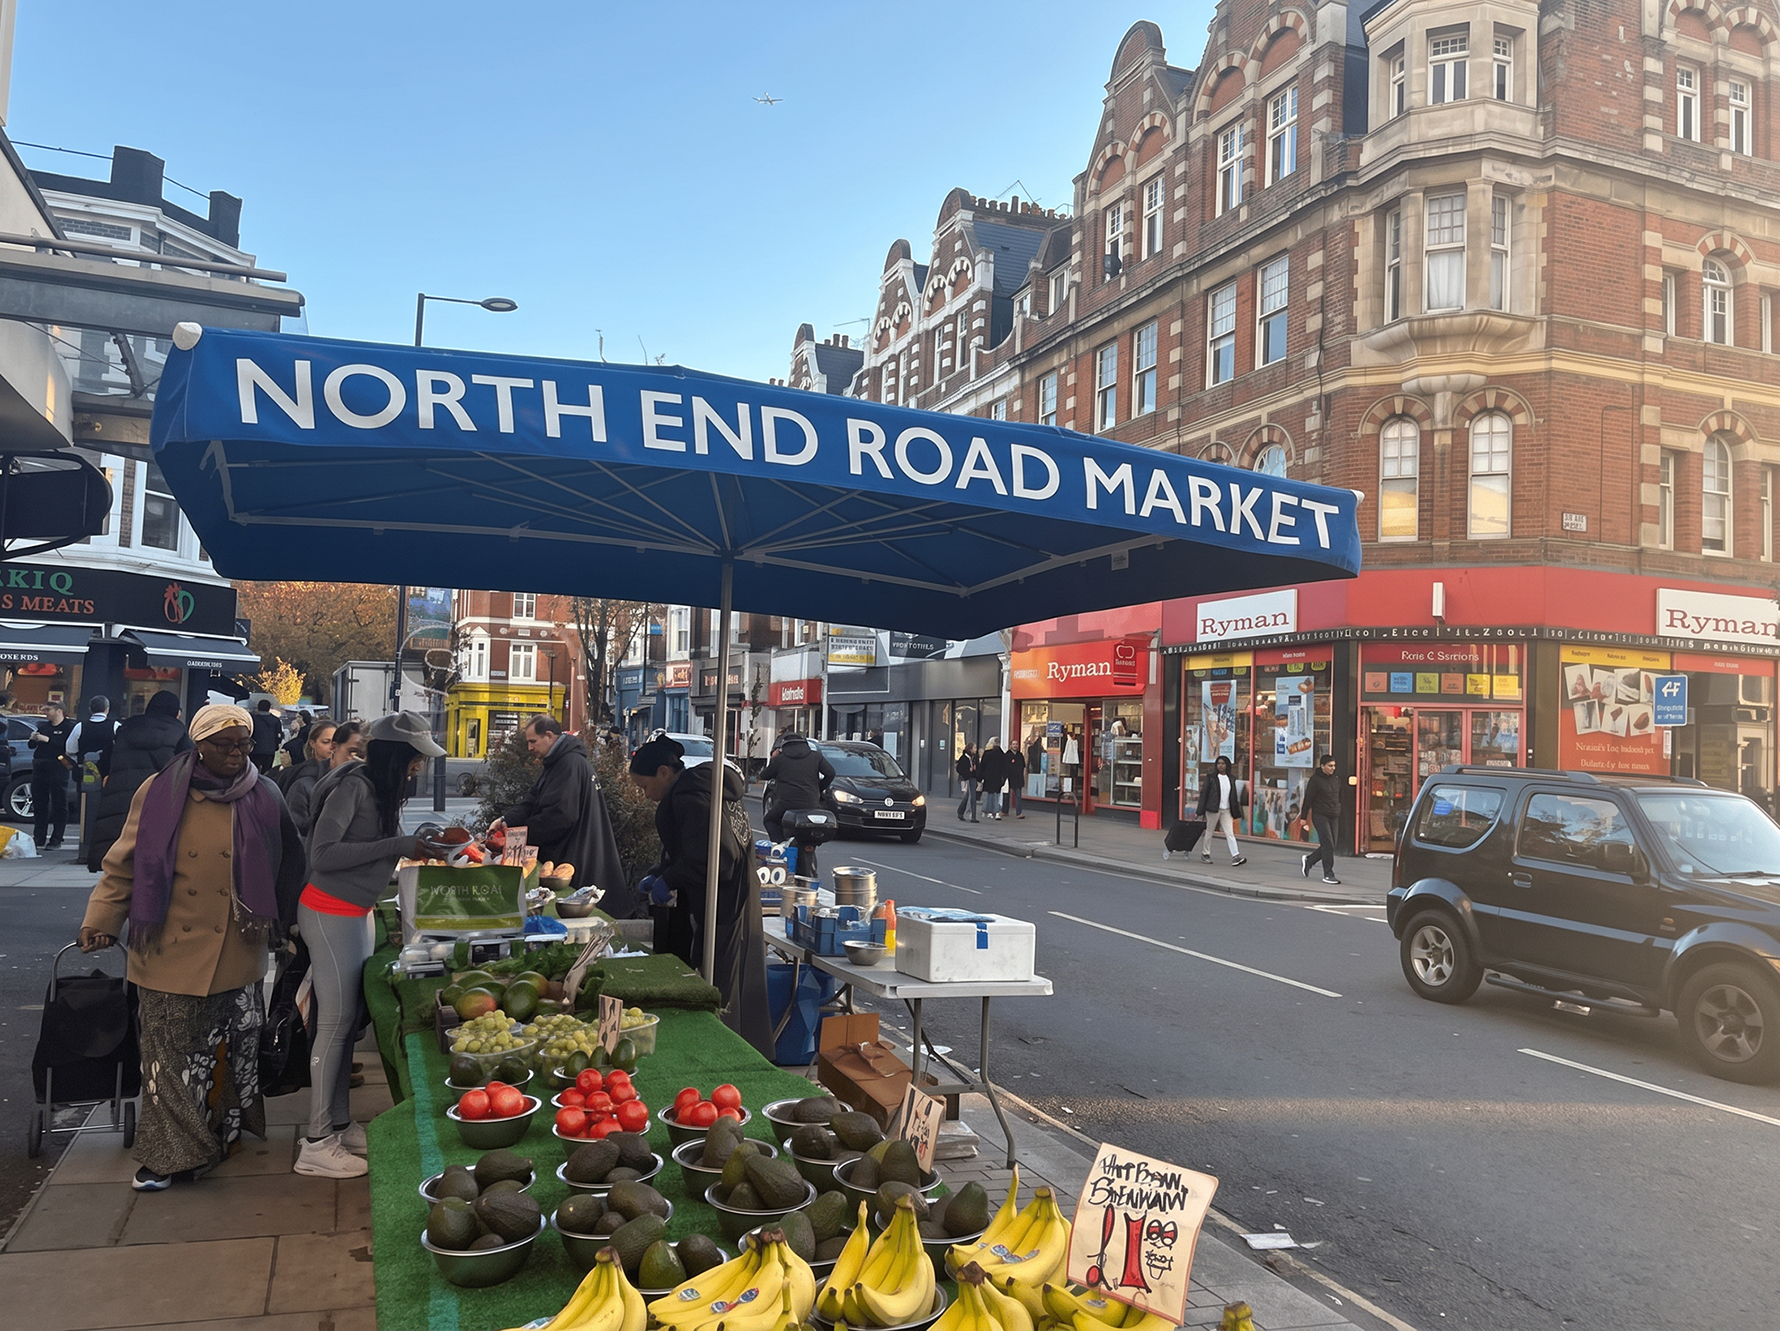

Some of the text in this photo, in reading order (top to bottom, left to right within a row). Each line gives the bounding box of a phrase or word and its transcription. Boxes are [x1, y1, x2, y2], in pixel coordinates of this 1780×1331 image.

[236, 358, 1340, 550] NORTH END ROAD MARKET
[0, 569, 74, 596] KIQ
[20, 595, 95, 615] MEATS
[1200, 611, 1289, 637] Ryman
[1665, 608, 1778, 637] Ryman
[1047, 662, 1112, 682] Ryman
